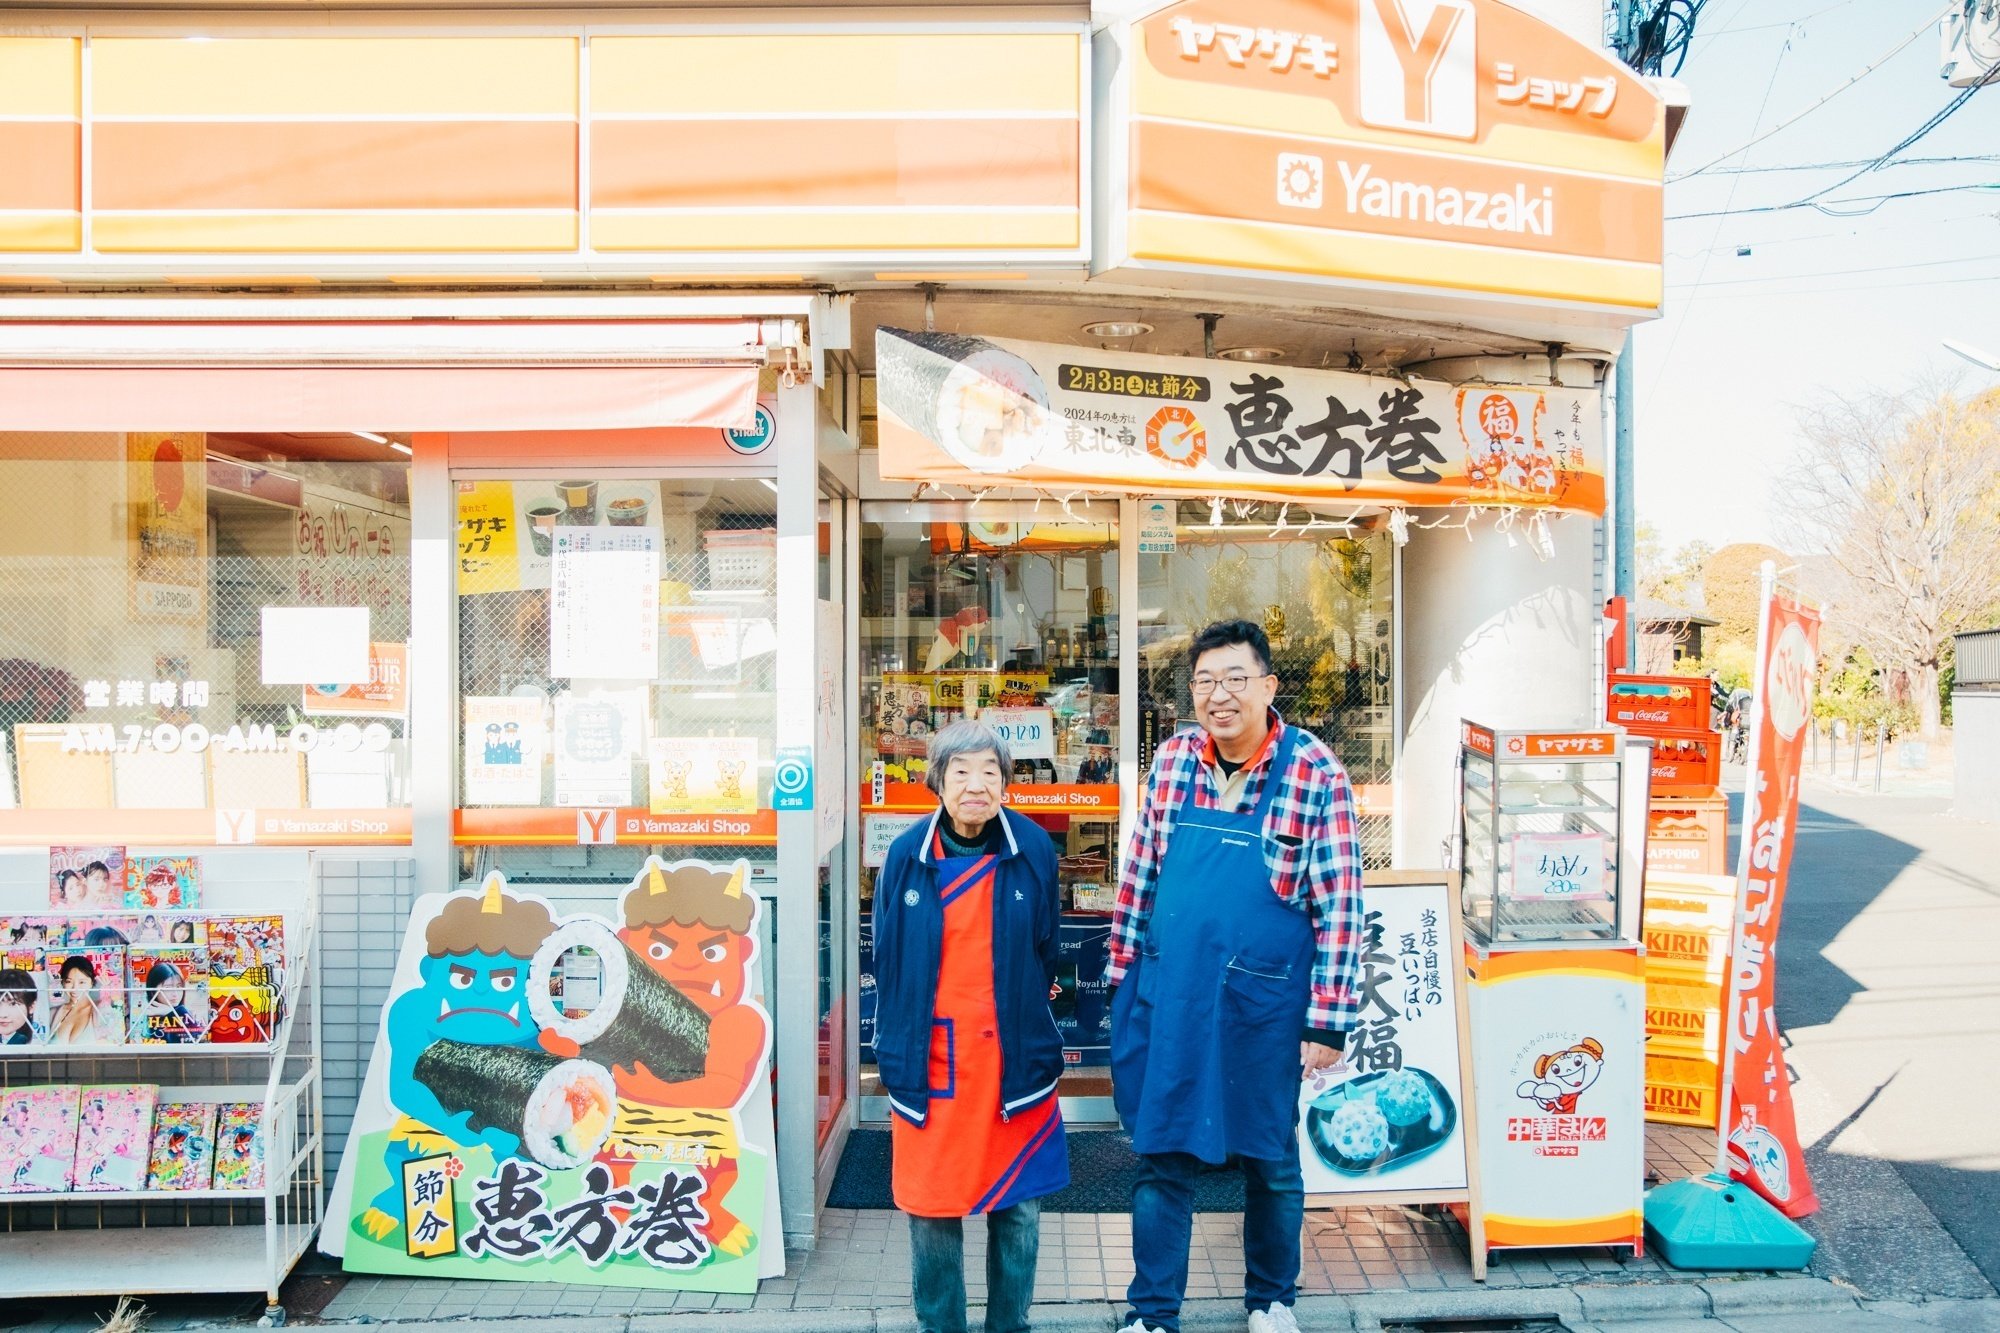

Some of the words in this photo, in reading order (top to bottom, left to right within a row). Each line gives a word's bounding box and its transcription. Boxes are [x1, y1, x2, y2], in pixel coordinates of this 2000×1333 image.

[1169, 15, 1339, 77] ヤマザキ
[1494, 63, 1618, 117] ショップ
[1337, 160, 1553, 236] Yamazaki
[1482, 399, 1515, 436] 福
[732, 427, 765, 437] STRIKE
[1063, 423, 1142, 459] 東北東
[1224, 372, 1448, 492] 恵方巻
[369, 664, 401, 685] OUR
[84, 679, 209, 708] 営業時間
[881, 691, 905, 726] 恵方巻
[1471, 731, 1492, 750] ヤマザキ
[1536, 738, 1604, 753] ヤマザキ
[875, 772, 883, 803] 自動ドア
[1012, 792, 1066, 804] Yamazaki
[1069, 792, 1101, 807] Shop
[1354, 795, 1371, 807] op
[223, 811, 246, 842] Y
[281, 819, 348, 833] Yamazaki
[350, 819, 389, 835] Shop
[582, 811, 611, 842] Y
[642, 818, 709, 833] Yamazaki
[712, 818, 751, 835] Shop
[1536, 854, 1589, 877] 肉まん
[1060, 941, 1082, 950] read
[1646, 931, 1712, 954] KIRIN
[1420, 908, 1442, 1006] 当店自慢の
[1076, 979, 1100, 992] Royal
[1398, 932, 1422, 1022] 豆いっぱい
[1057, 1019, 1079, 1028] read
[1645, 1008, 1705, 1029] KIRIN
[1508, 1117, 1606, 1141] 中華まん
[1543, 1146, 1578, 1156] ヤマザキ
[413, 1165, 449, 1243] 節分
[463, 1161, 711, 1265] 恵方巻
